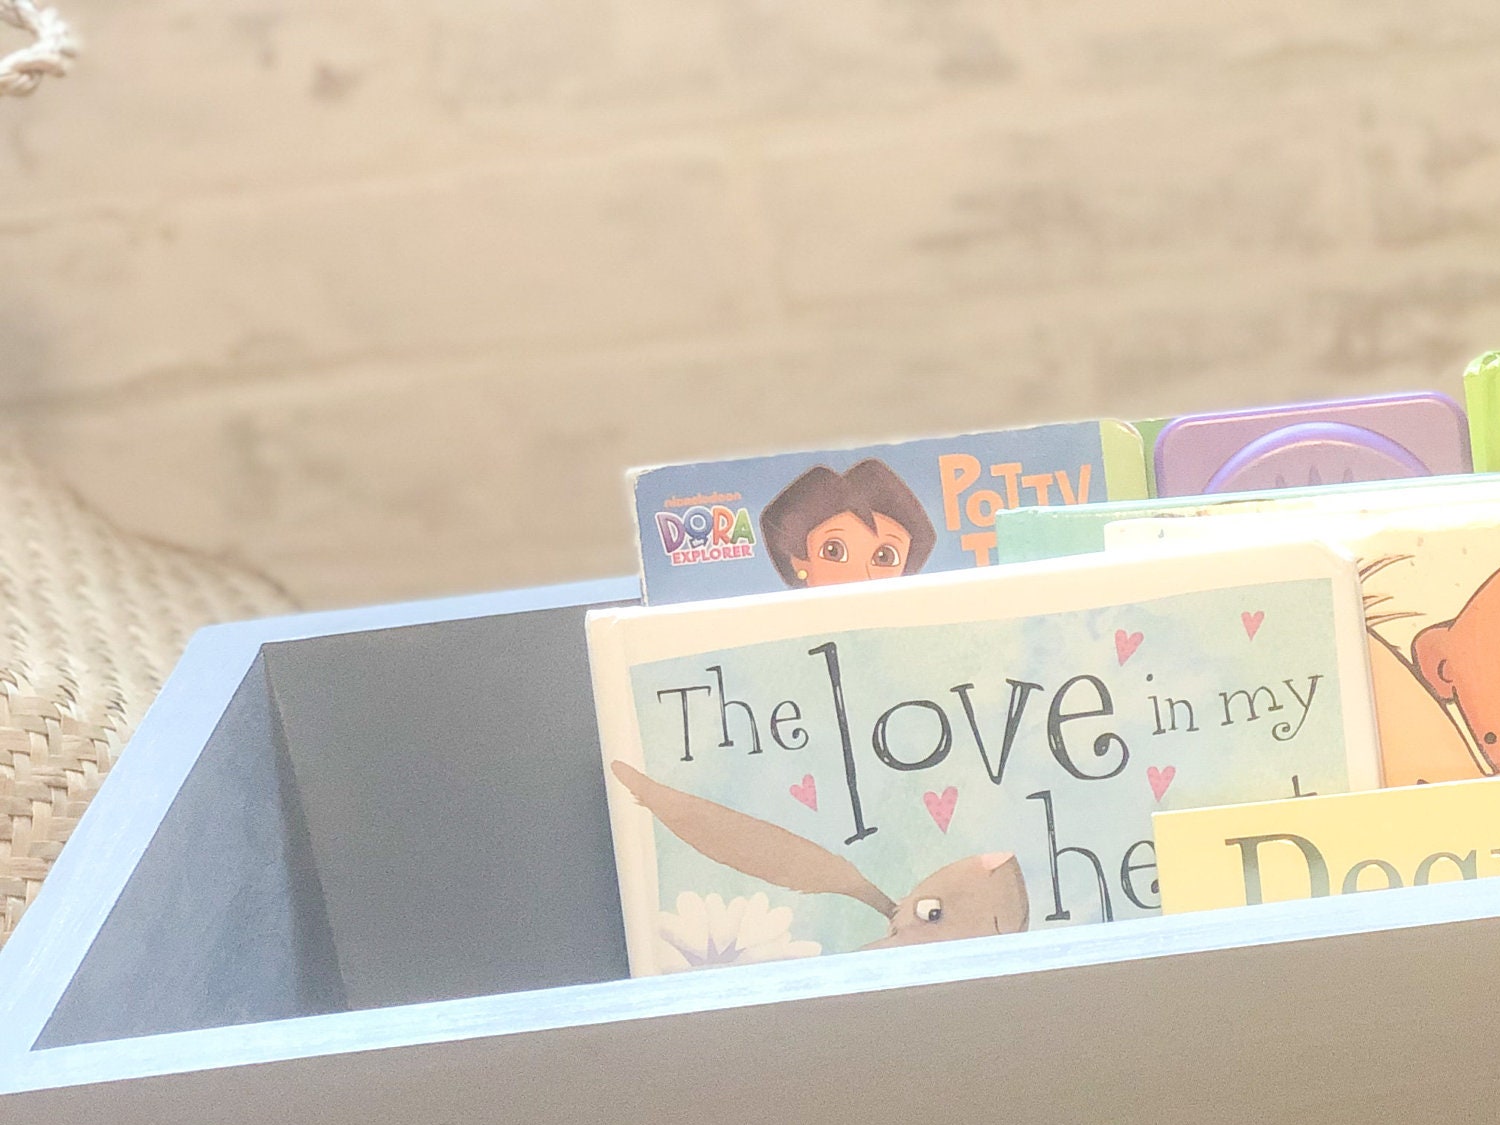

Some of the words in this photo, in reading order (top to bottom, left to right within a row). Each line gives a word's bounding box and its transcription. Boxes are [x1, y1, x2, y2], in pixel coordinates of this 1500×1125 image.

[655, 505, 756, 555] DORA
[671, 543, 755, 566] EXPLORER
[656, 665, 809, 762] The
[808, 641, 1131, 845] love
[1145, 673, 1199, 737] in
[1218, 673, 1325, 742] my
